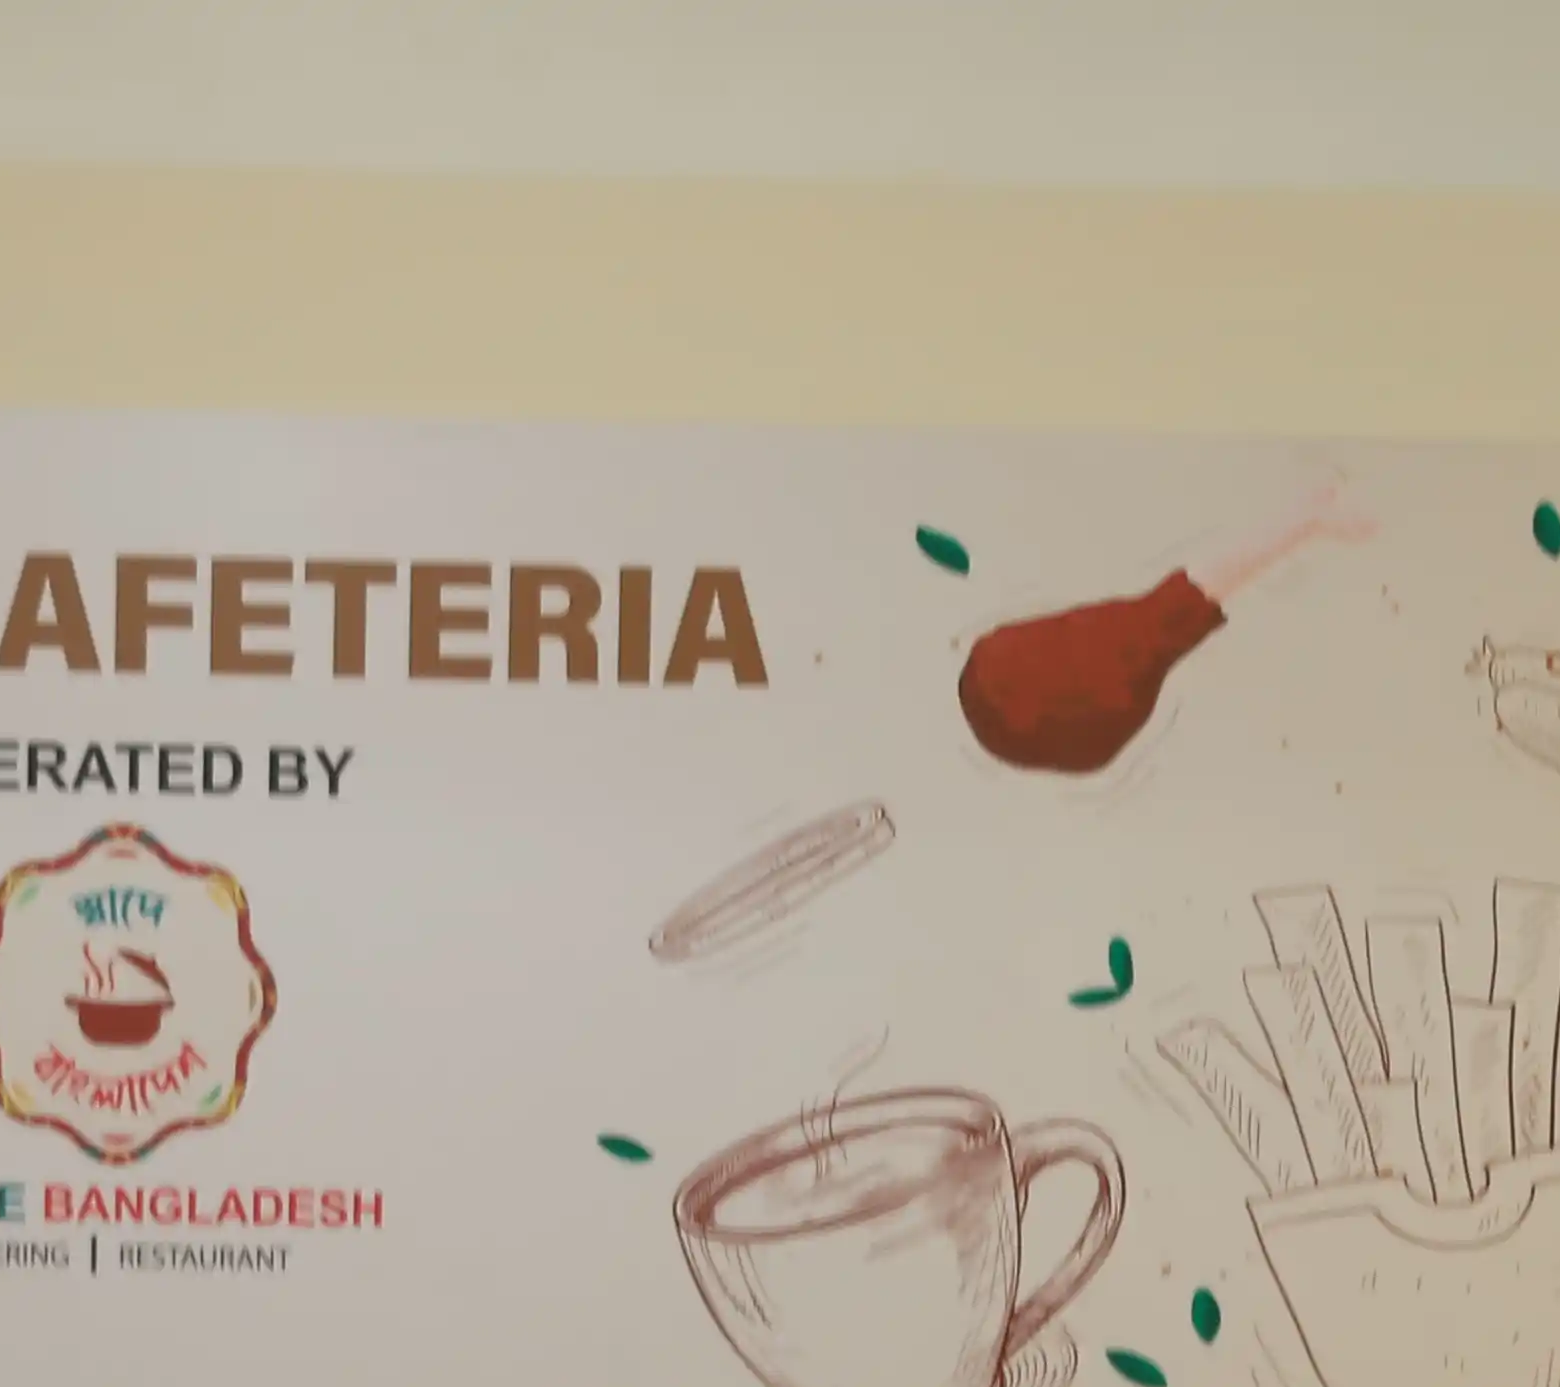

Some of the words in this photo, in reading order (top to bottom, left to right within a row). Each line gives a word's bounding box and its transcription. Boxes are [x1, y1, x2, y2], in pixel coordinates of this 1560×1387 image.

[266, 746, 355, 800] BY
[43, 1183, 385, 1230] BANGLADESH
[119, 1241, 291, 1274] RESTAURANT
